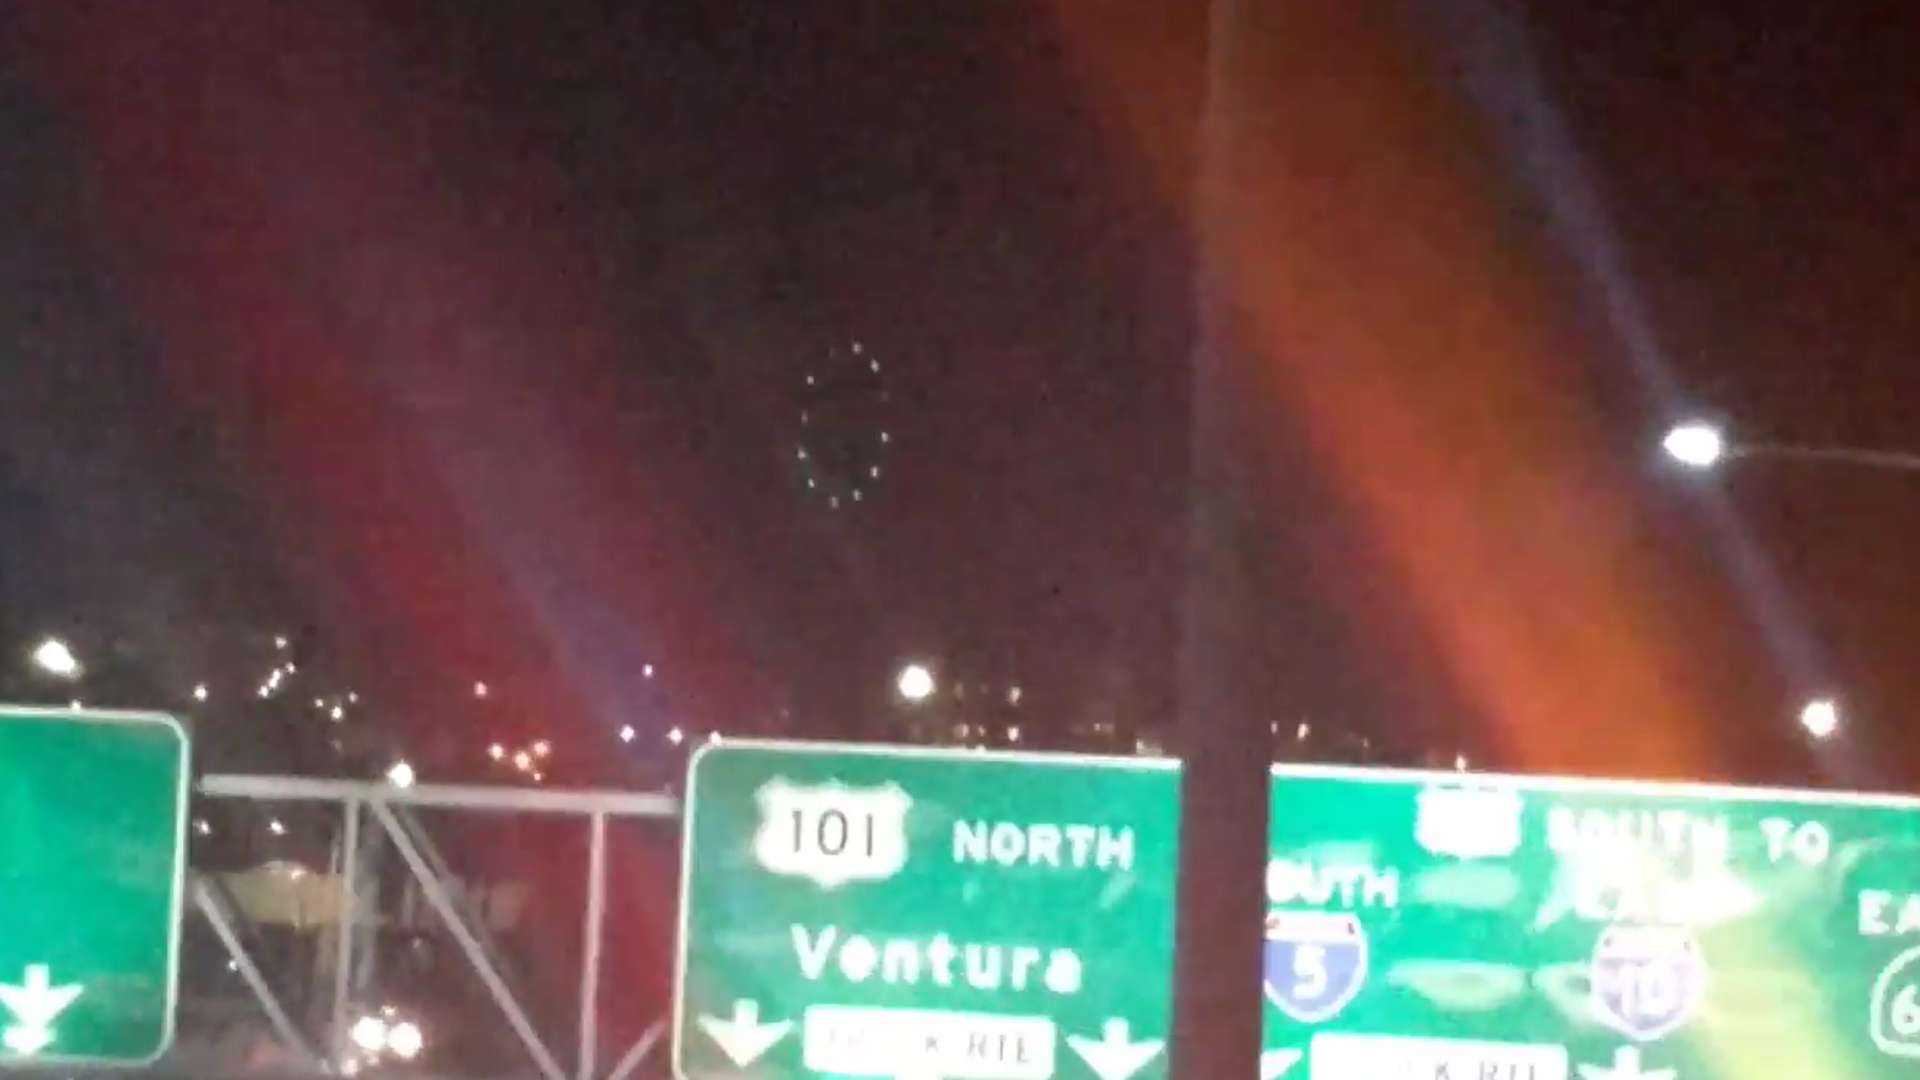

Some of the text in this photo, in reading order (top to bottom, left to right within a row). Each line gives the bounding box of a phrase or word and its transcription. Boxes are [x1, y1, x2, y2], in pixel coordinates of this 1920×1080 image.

[791, 807, 1136, 871] 101 NORTH
[1759, 816, 1830, 866] TO
[1266, 857, 1401, 910] OUTH
[790, 923, 1084, 994] Ventura
[1293, 942, 1329, 1000] 5
